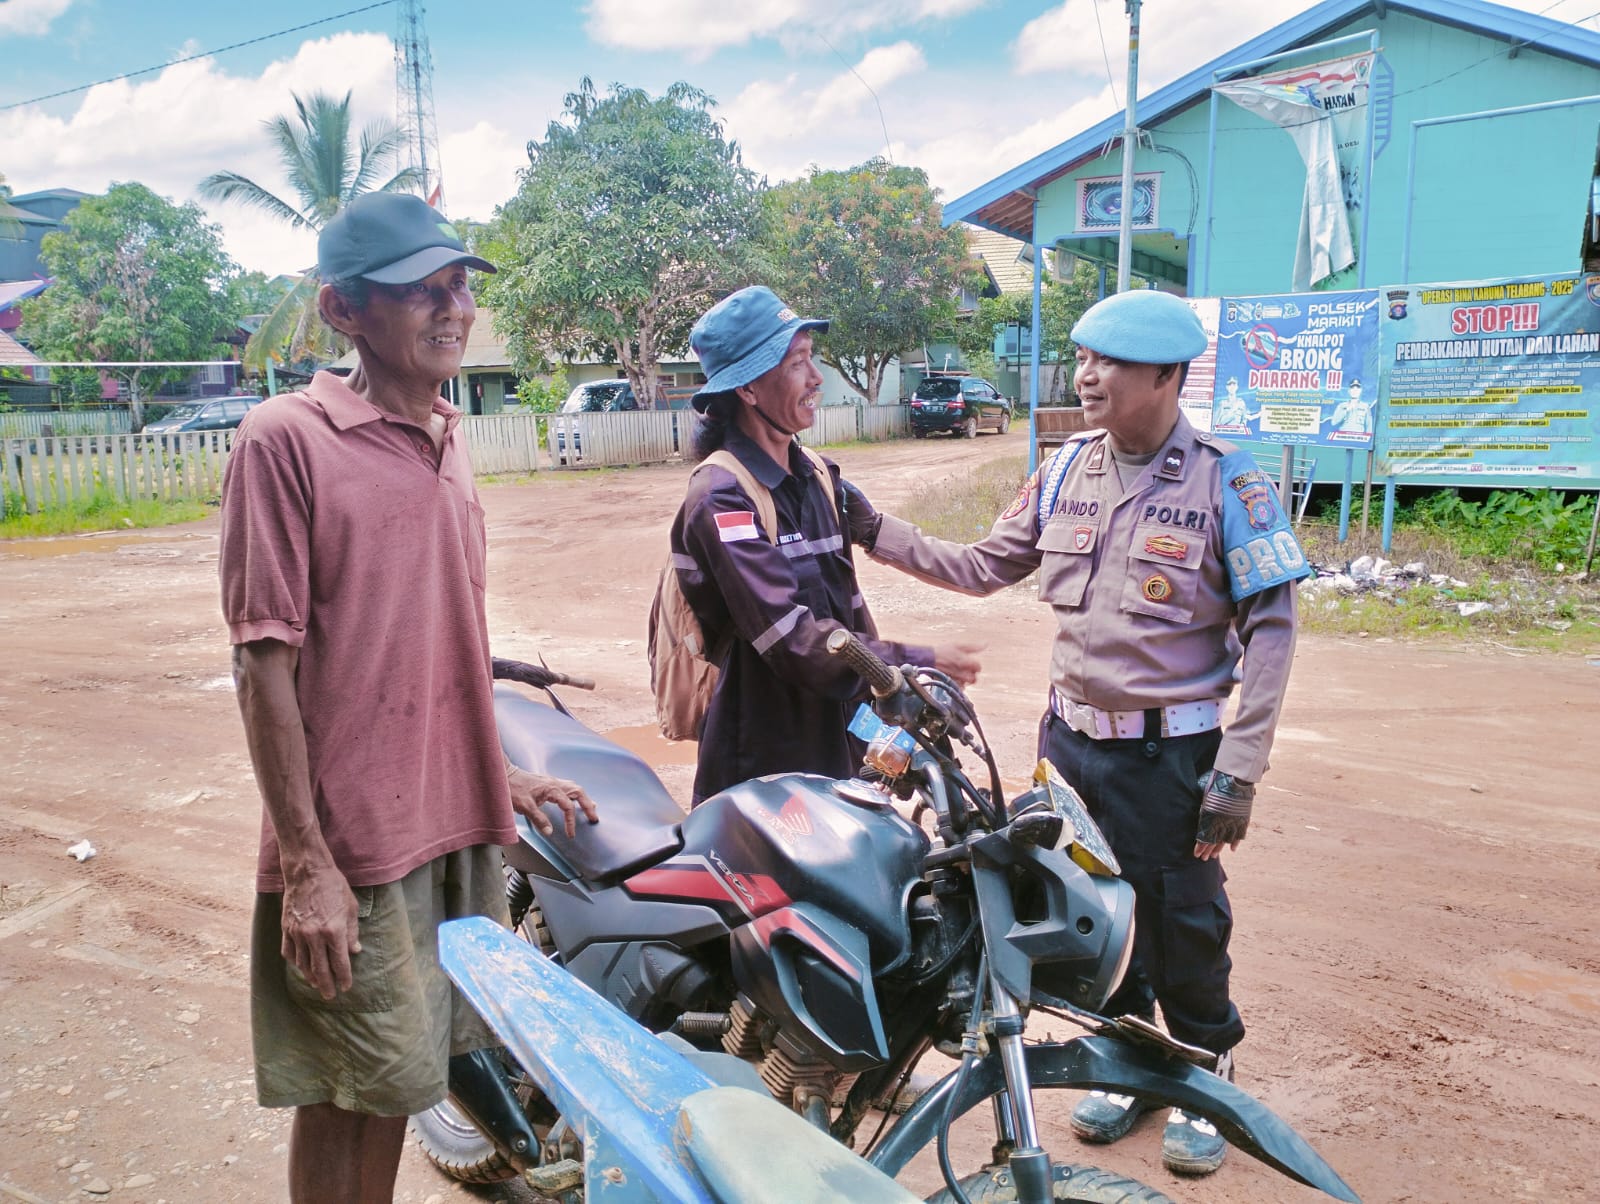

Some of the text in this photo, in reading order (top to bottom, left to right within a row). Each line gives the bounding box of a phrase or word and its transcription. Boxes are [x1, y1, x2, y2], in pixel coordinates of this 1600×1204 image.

[1454, 289, 1472, 303] BINA
[1308, 301, 1366, 316] POLSEK
[1452, 303, 1540, 335] STOP!!!
[1307, 314, 1364, 329] MARIKIT
[1296, 333, 1345, 348] KNALPOT
[1396, 333, 1600, 361] PEMBAKARAN HUTAN DAN LAHAN
[1280, 348, 1343, 370] BRONG
[1248, 369, 1321, 391] DILARANG
[1143, 503, 1207, 530] POLRI
[709, 848, 755, 907] VERZA
